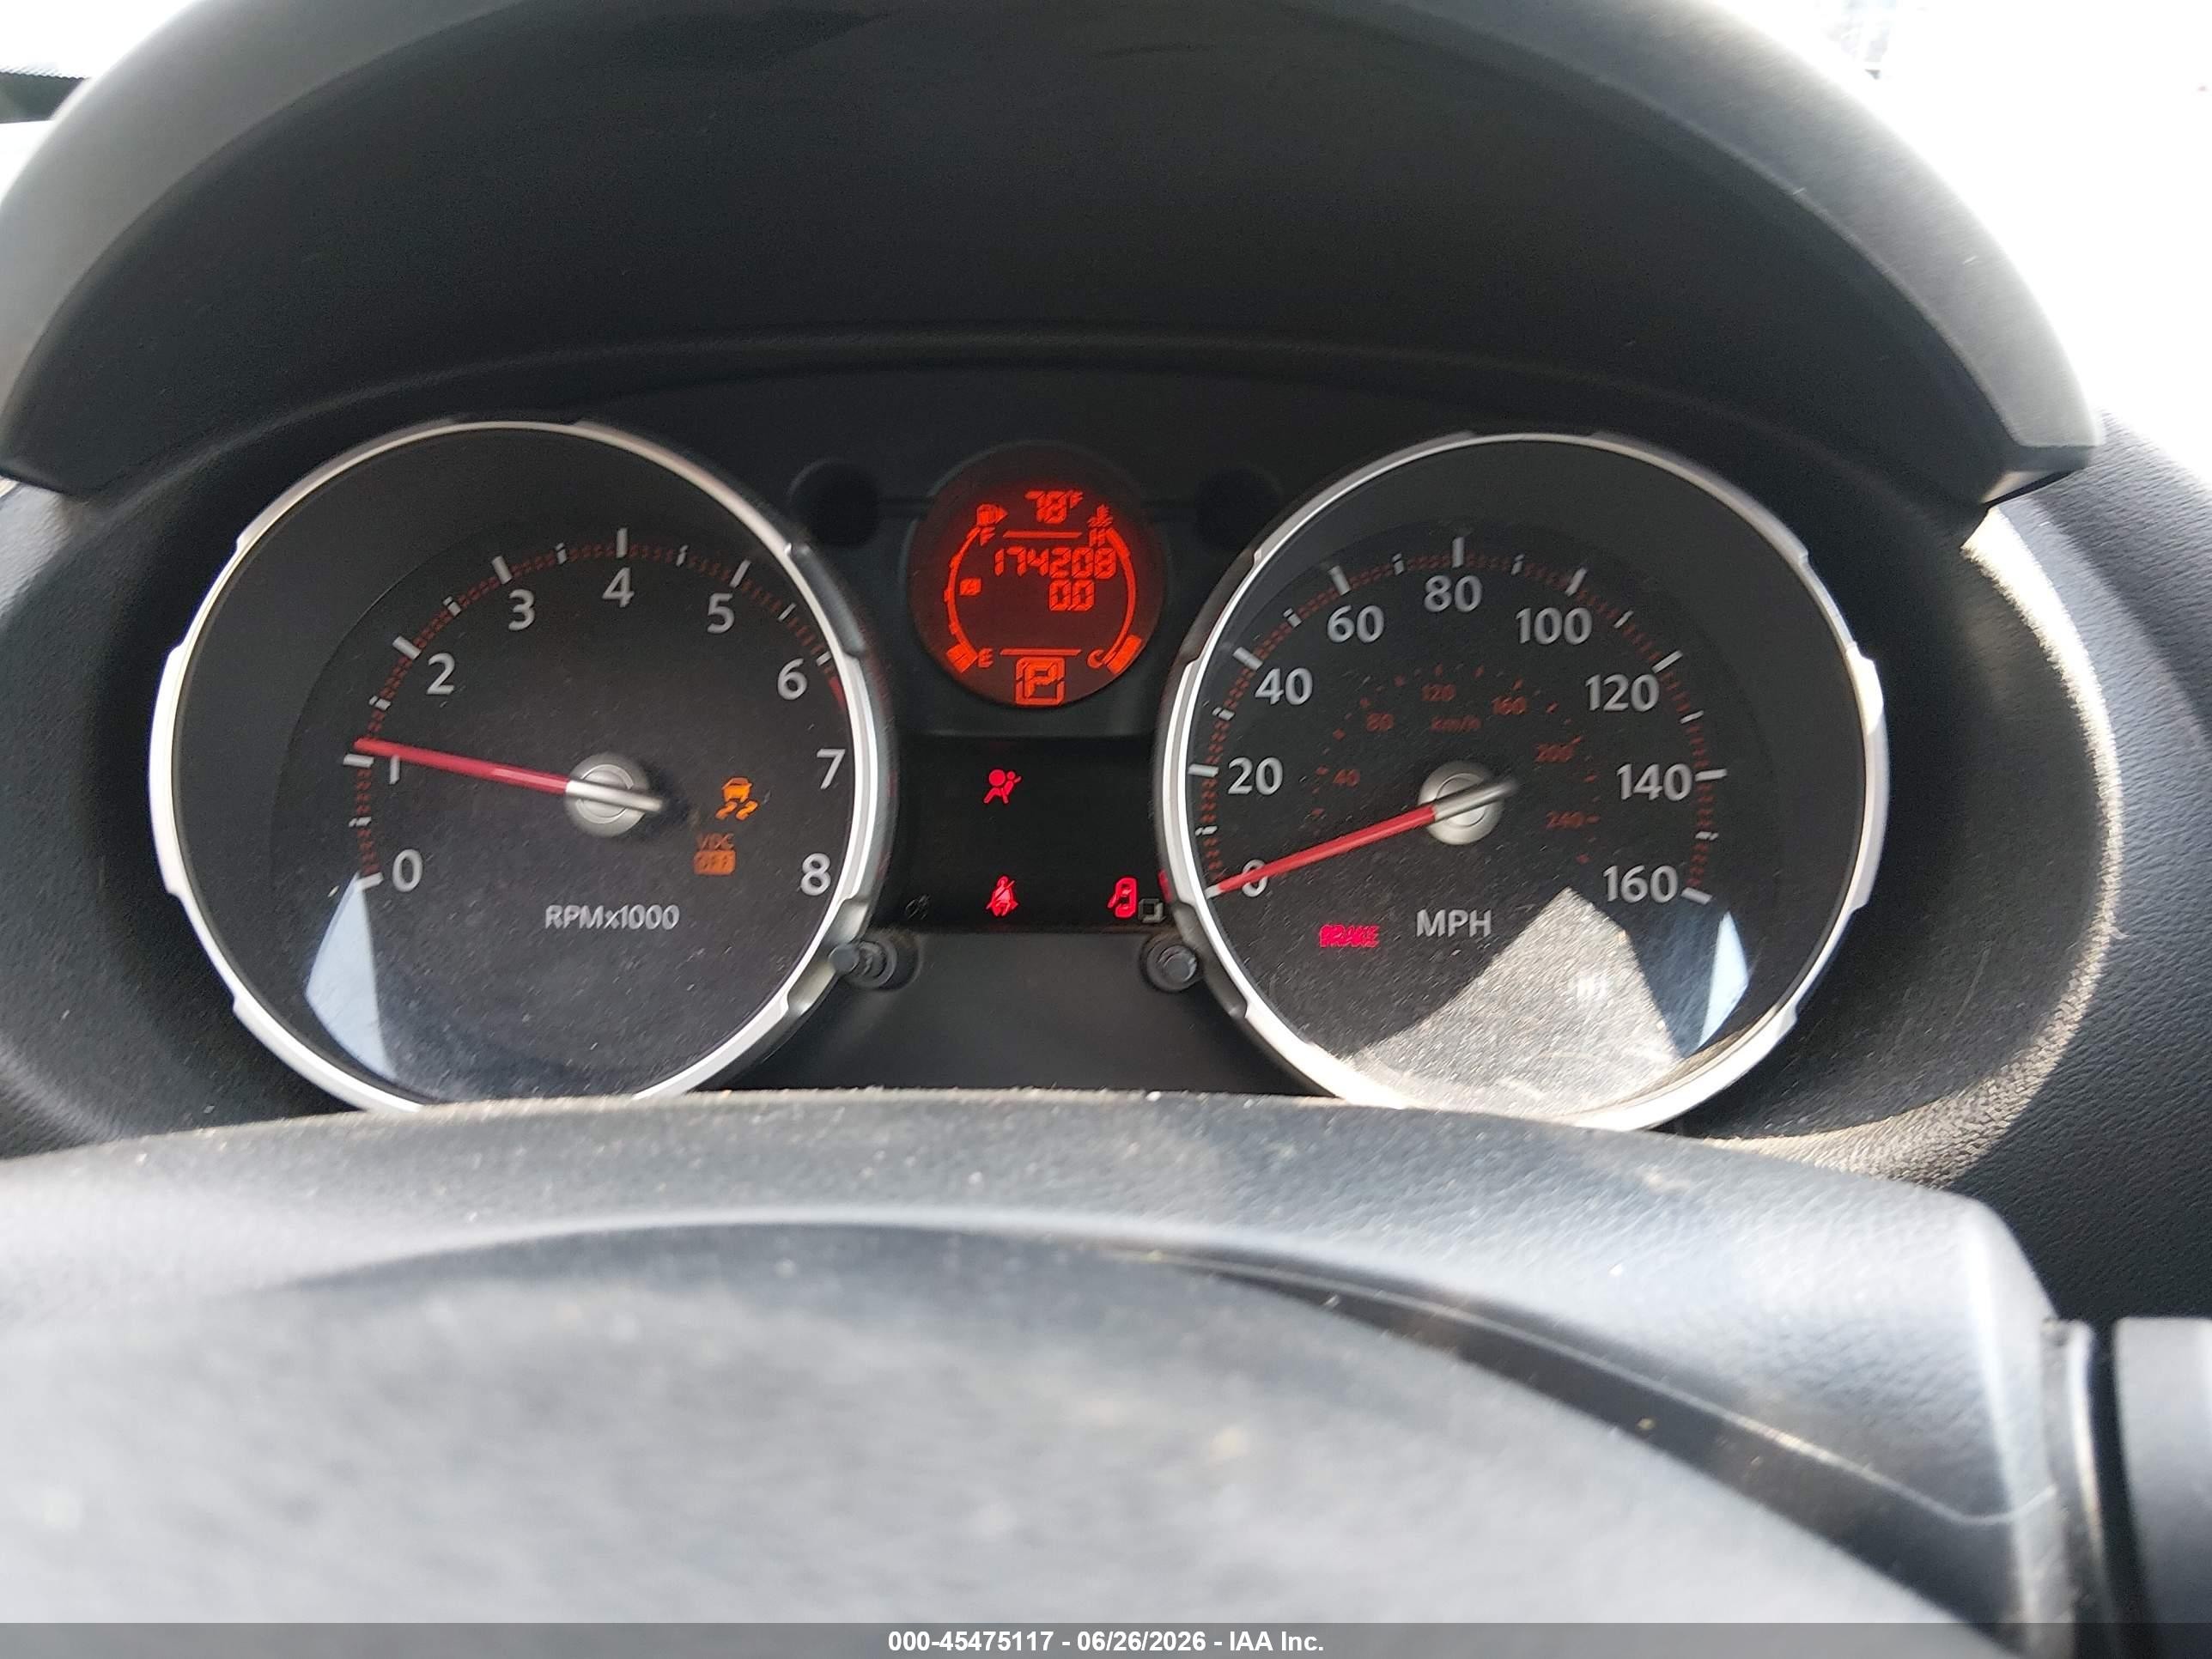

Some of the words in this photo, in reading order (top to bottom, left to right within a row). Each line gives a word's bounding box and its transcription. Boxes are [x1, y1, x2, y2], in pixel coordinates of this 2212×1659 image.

[994, 546, 1116, 579] 174208
[602, 567, 634, 608] 4
[1424, 574, 1483, 612] 80
[508, 589, 535, 631] 3
[707, 592, 735, 634] 5
[1327, 605, 1384, 642] 60
[1516, 607, 1592, 645] 100
[426, 653, 455, 696] 2
[977, 648, 994, 668] E
[1086, 649, 1104, 669] C
[777, 658, 807, 701] 6
[1254, 667, 1313, 706] 40
[1585, 674, 1660, 712] 120
[389, 755, 400, 785] 1
[817, 749, 846, 789] 7
[1228, 757, 1284, 795] 20
[1333, 769, 1360, 787] 40
[1617, 763, 1692, 801] 140
[392, 848, 422, 892] 0
[800, 853, 831, 896] 8
[1242, 859, 1268, 897] 0
[1603, 865, 1678, 903] 160
[544, 904, 680, 930] RPMx1000
[1417, 909, 1492, 938] MPH
